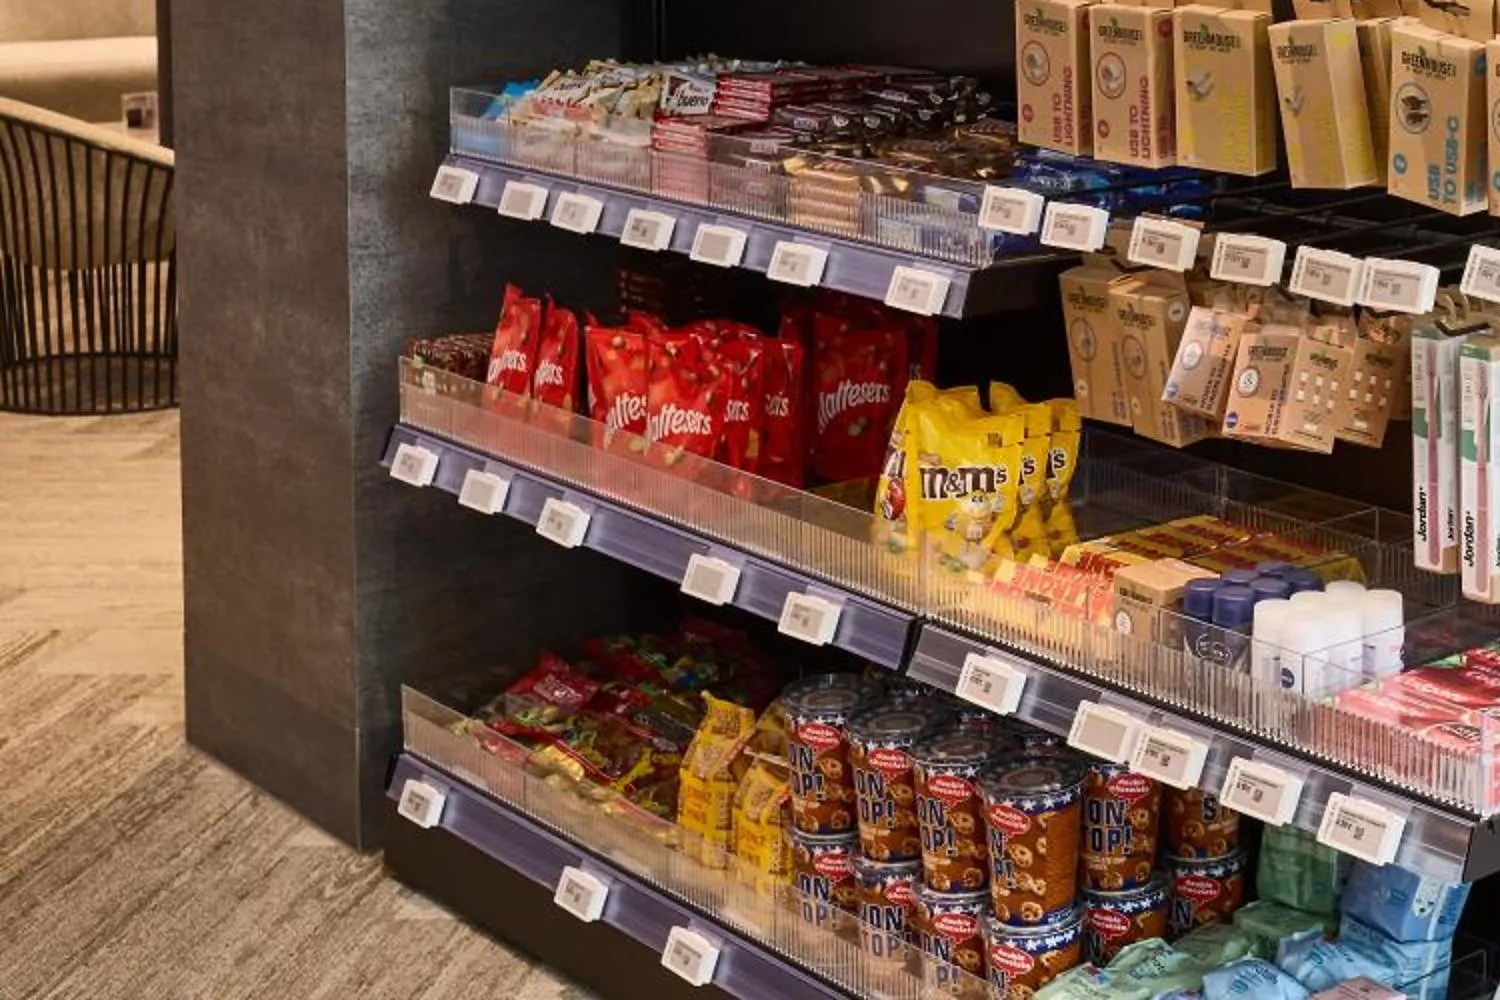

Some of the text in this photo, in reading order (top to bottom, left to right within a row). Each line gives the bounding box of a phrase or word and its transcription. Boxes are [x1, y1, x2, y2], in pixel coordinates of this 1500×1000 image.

[1053, 93, 1062, 144] USB TO
[1064, 66, 1073, 147] LIGHTNING
[1129, 105, 1139, 157] USB TO
[1140, 76, 1150, 159] LIGHTNING
[1416, 488, 1427, 542] Jordan
[1463, 514, 1475, 568] Jordan
